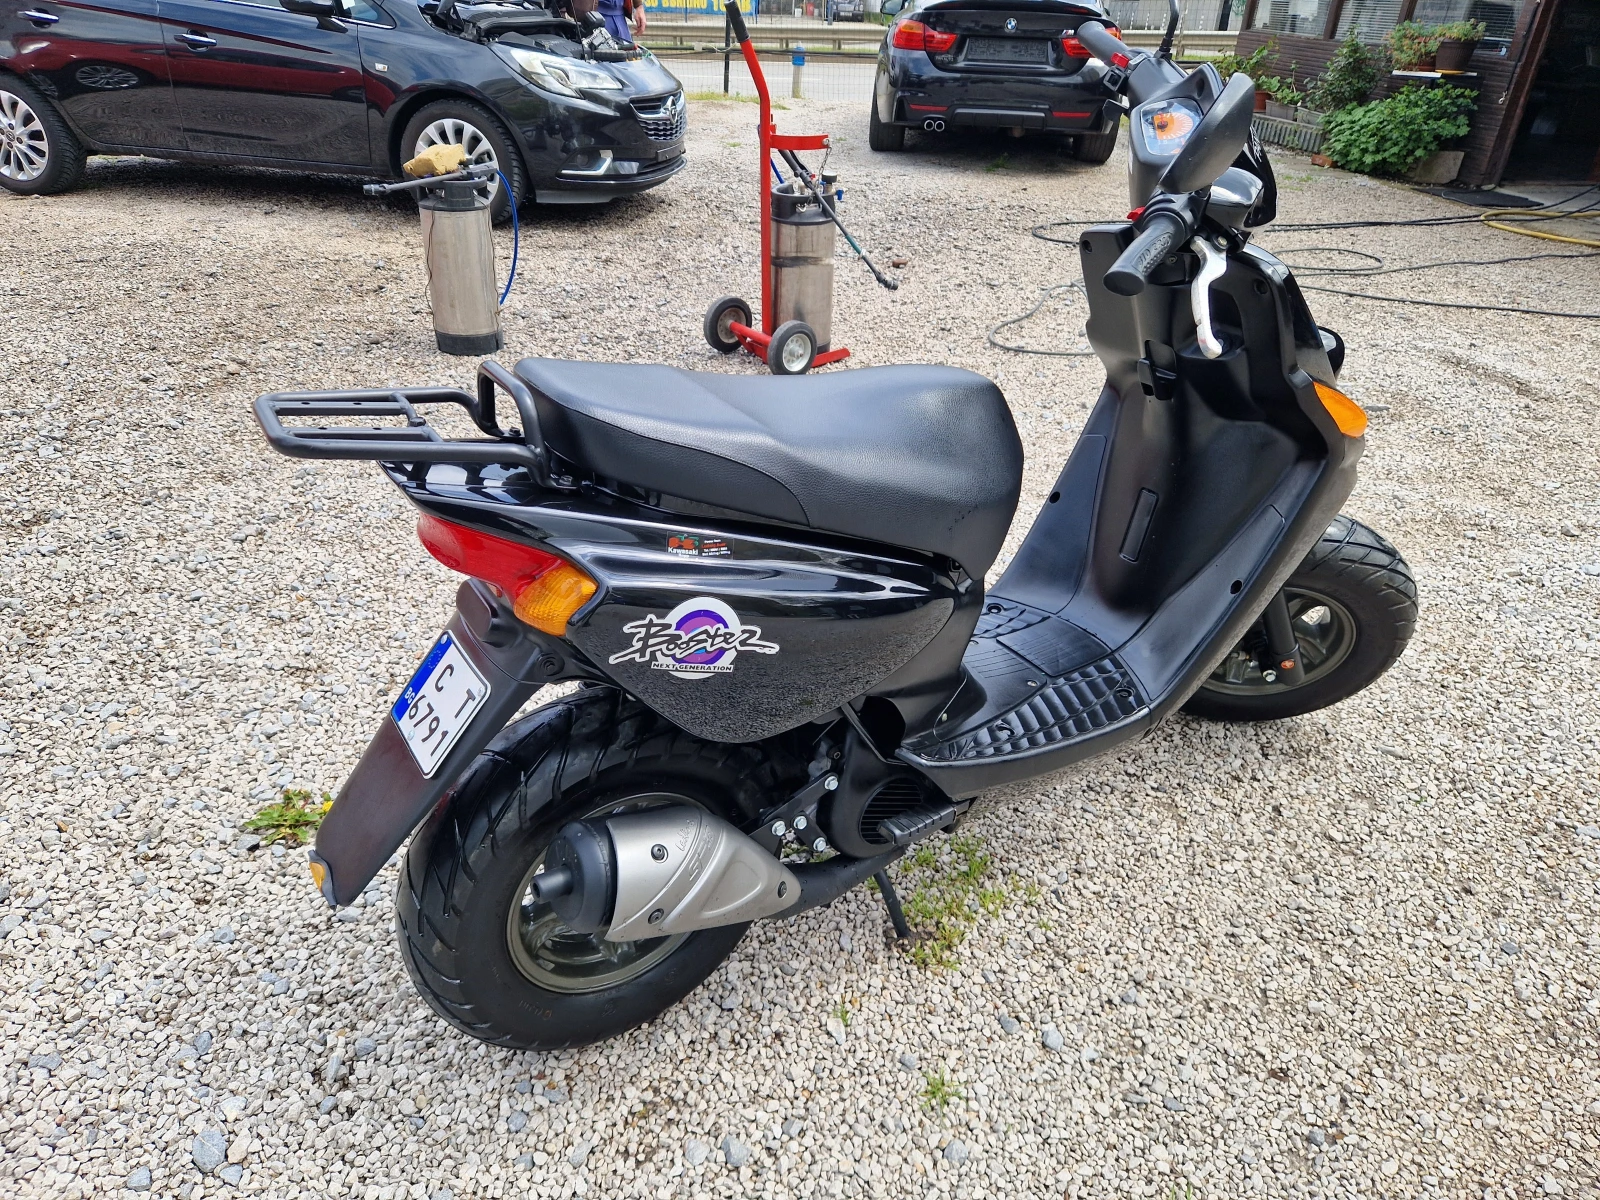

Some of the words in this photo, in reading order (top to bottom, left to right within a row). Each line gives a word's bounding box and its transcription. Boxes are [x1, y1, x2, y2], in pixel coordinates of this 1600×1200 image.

[667, 546, 699, 556] Kawasaki
[652, 662, 676, 670] NEXT
[678, 664, 733, 672] GENERATION
[404, 686, 416, 704] BG
[434, 663, 455, 693] C
[453, 688, 477, 720] T
[408, 694, 450, 758] 6791
